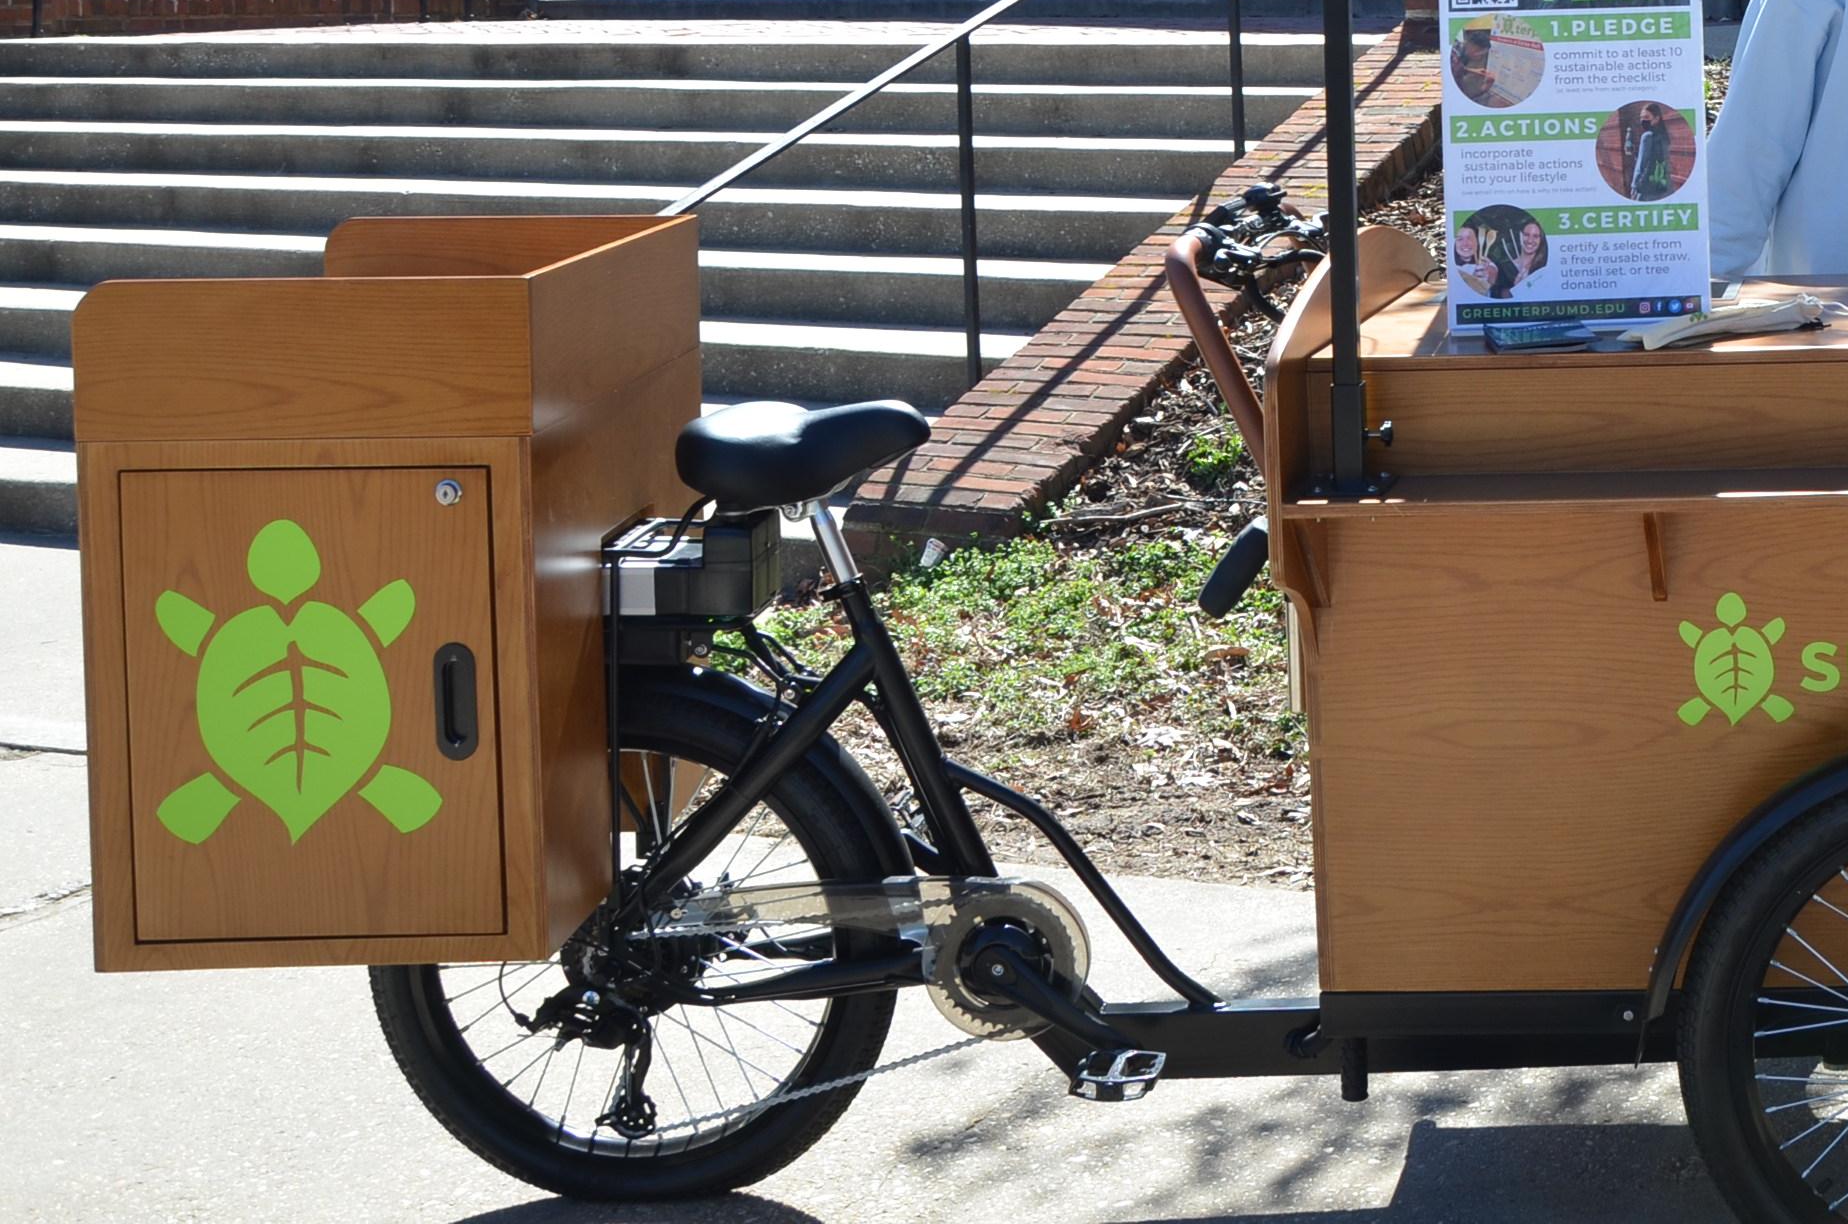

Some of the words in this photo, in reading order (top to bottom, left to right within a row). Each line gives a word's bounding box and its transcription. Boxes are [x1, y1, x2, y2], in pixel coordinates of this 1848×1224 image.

[1553, 48, 1602, 60] commit
[1606, 48, 1618, 59] to
[1621, 47, 1634, 58] at
[1637, 47, 1666, 58] least
[1669, 46, 1683, 57] 10
[1553, 60, 1625, 73] sustainable
[1627, 59, 1673, 71] actions
[1554, 74, 1585, 86] from
[1588, 73, 1608, 85] the
[1611, 72, 1666, 84] checklist
[1461, 148, 1534, 161] incorporate
[1464, 159, 1535, 172] sustainable
[1538, 158, 1583, 169] actions
[1462, 172, 1487, 185] into
[1489, 174, 1517, 186] your
[1520, 171, 1568, 184] lifestyle
[1559, 242, 1599, 254] certify
[1601, 241, 1609, 251] &
[1613, 240, 1649, 251] select
[1652, 239, 1682, 250] from
[1560, 256, 1568, 265] a
[1571, 254, 1595, 265] free
[1598, 252, 1651, 264] reusable
[1560, 266, 1602, 278] utensil
[1629, 267, 1641, 276] or
[1645, 265, 1670, 276] tree
[1561, 278, 1617, 290] donation
[1461, 303, 1626, 320] GREENTERP.UMD.EDU
